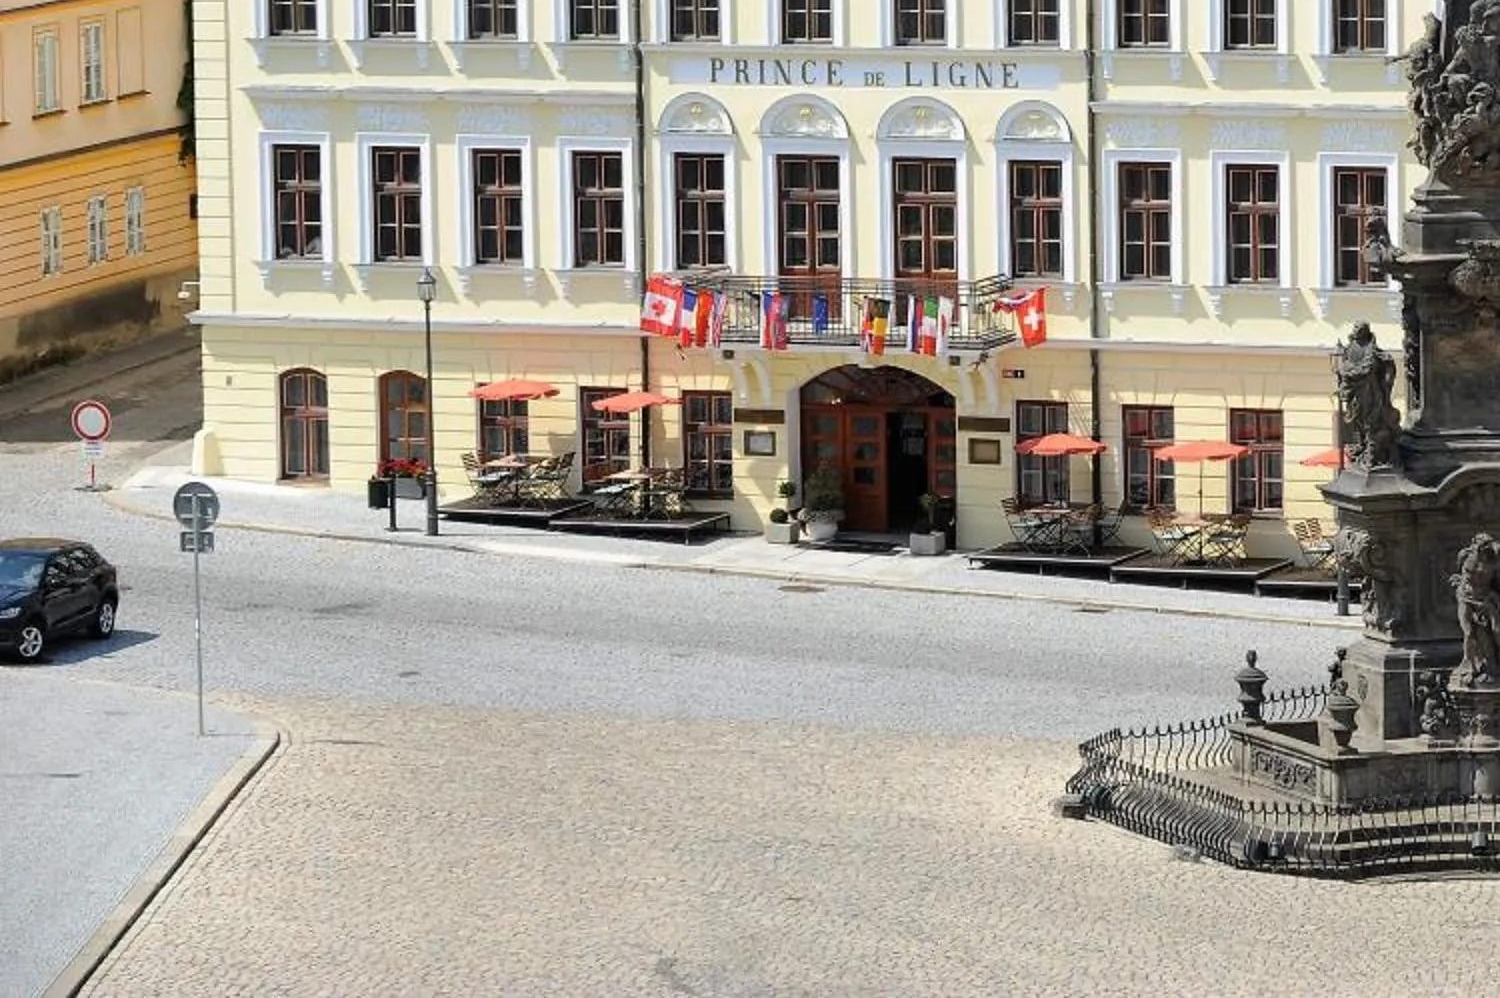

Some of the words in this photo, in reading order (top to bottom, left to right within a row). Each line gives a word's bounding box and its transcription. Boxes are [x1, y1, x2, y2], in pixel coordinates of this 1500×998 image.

[710, 57, 844, 87] PRINCE
[863, 72, 885, 87] DE
[903, 61, 1020, 89] LIGNE
